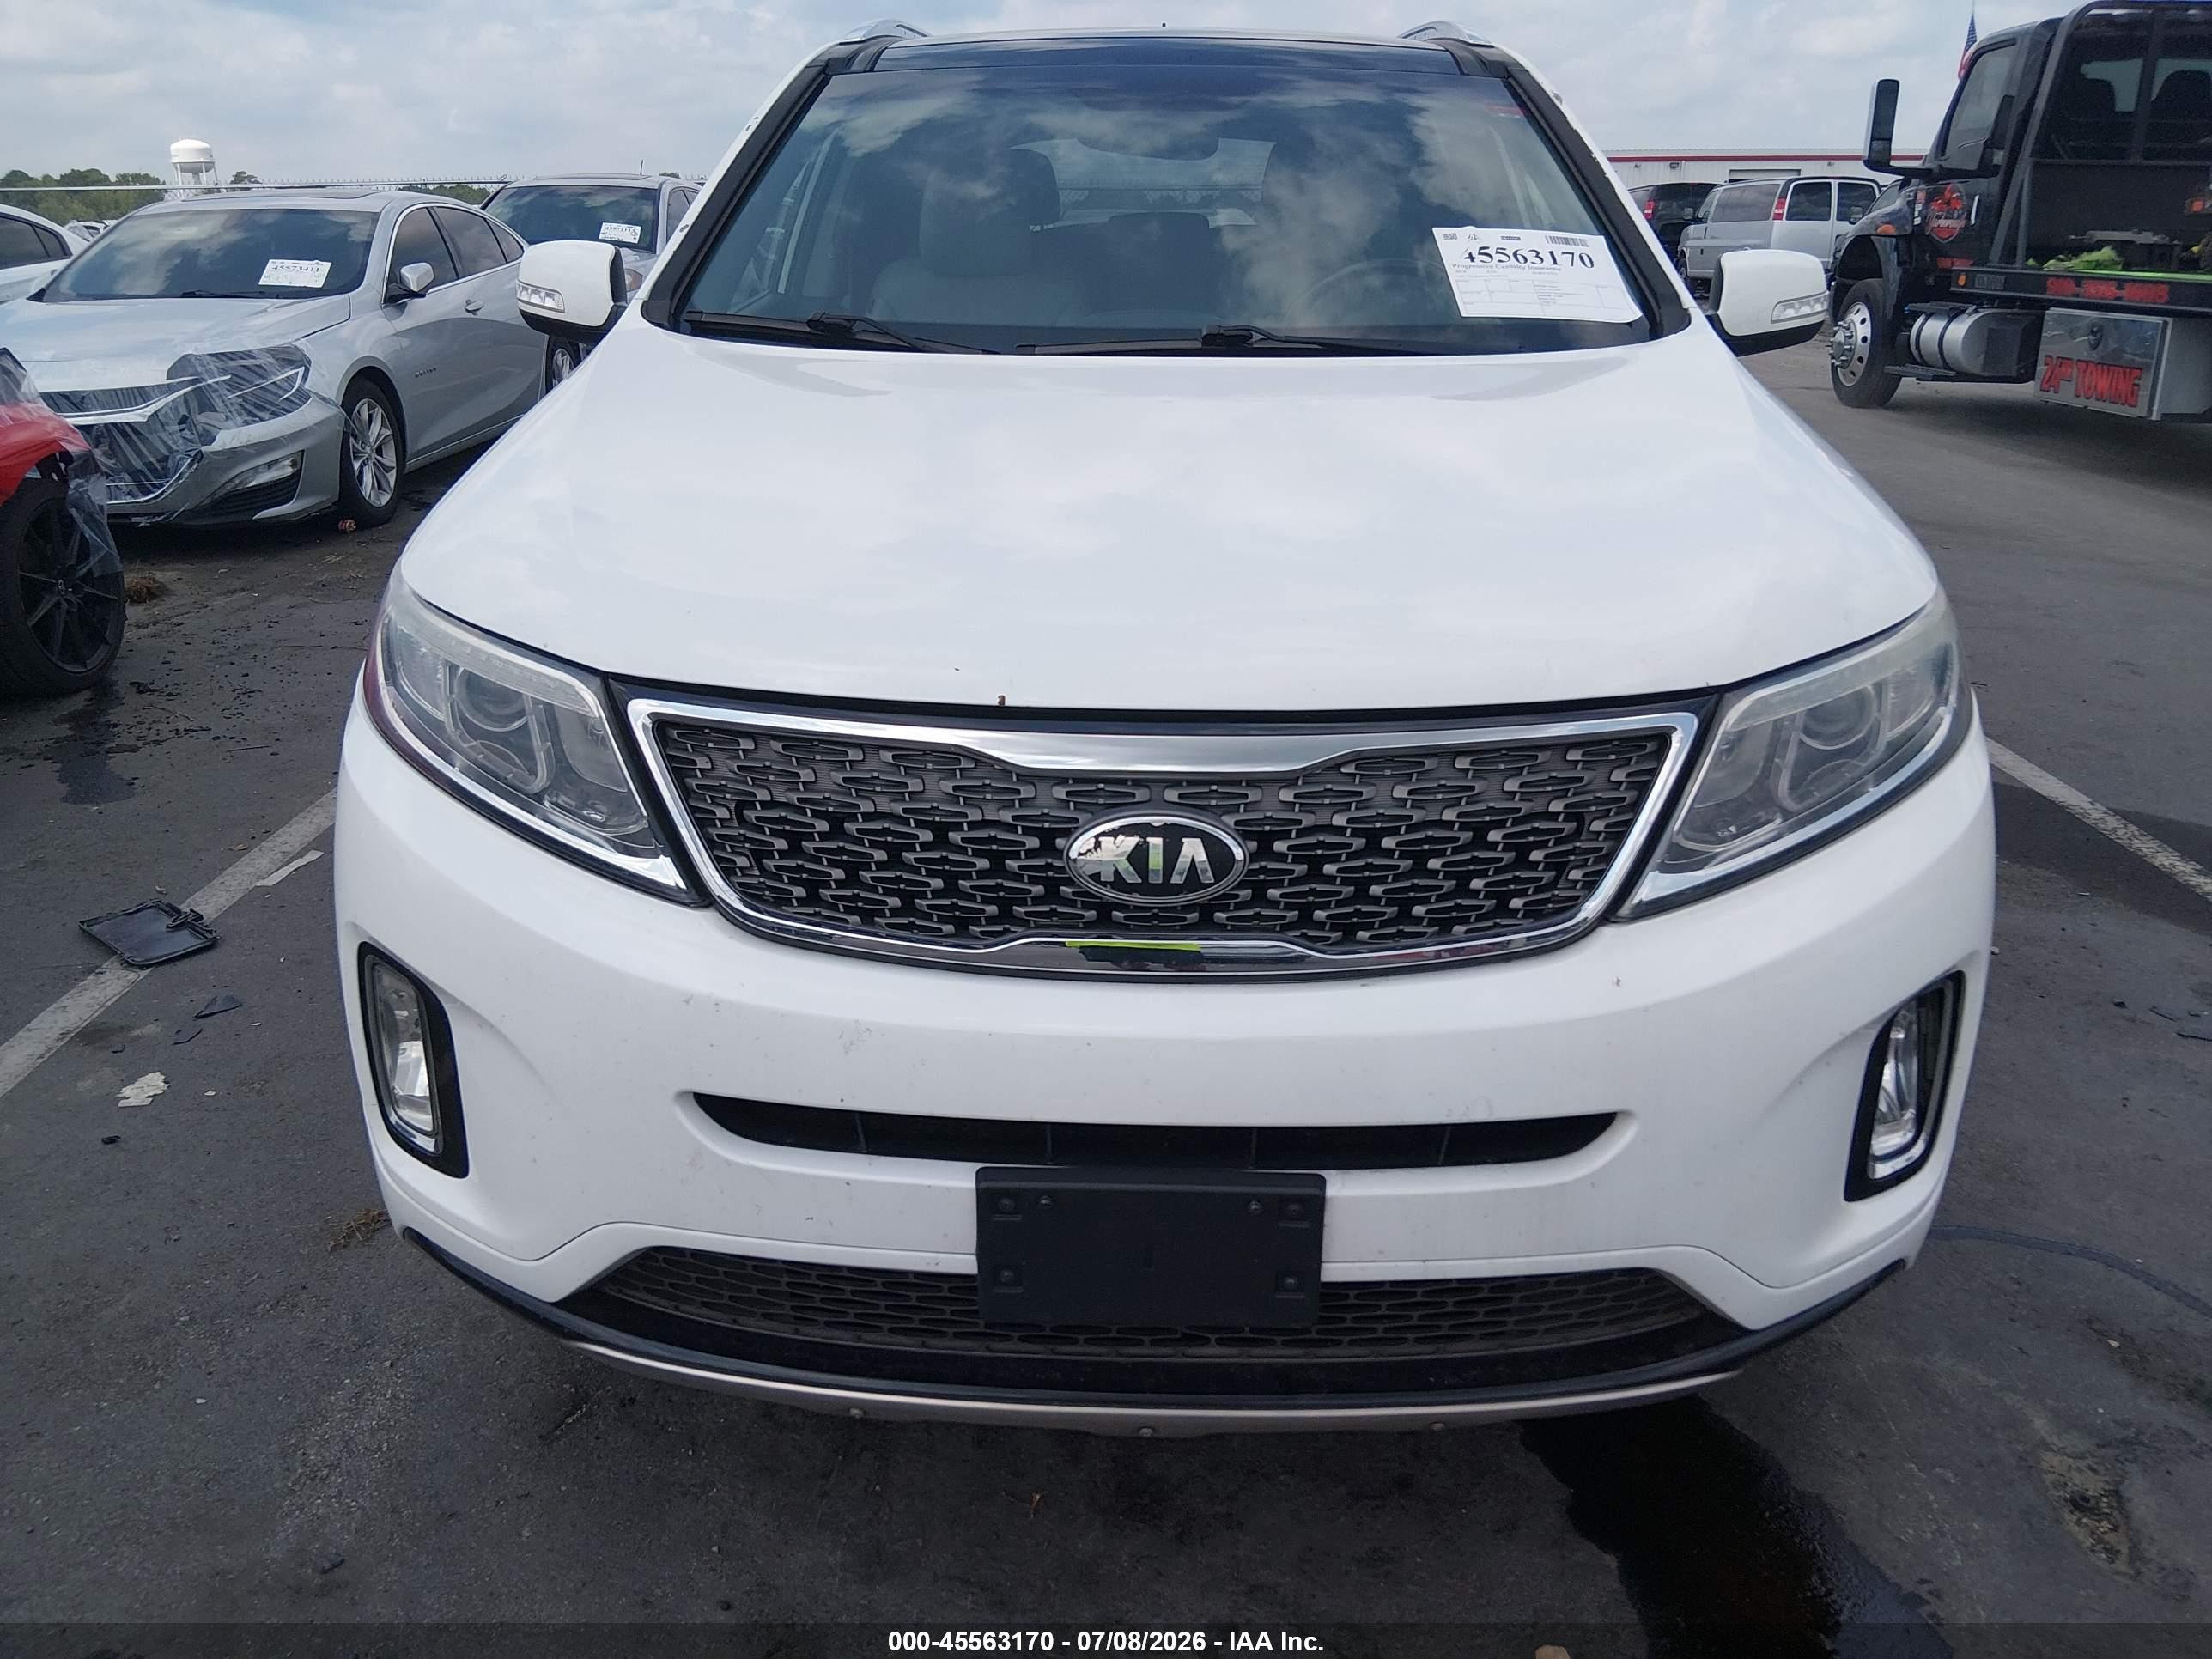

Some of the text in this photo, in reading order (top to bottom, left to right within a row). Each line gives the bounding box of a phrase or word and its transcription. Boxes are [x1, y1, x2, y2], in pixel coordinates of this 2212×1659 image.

[1461, 246, 1595, 269] 45563170
[2075, 358, 2142, 408] TOWING
[1097, 836, 1215, 884] KIA
